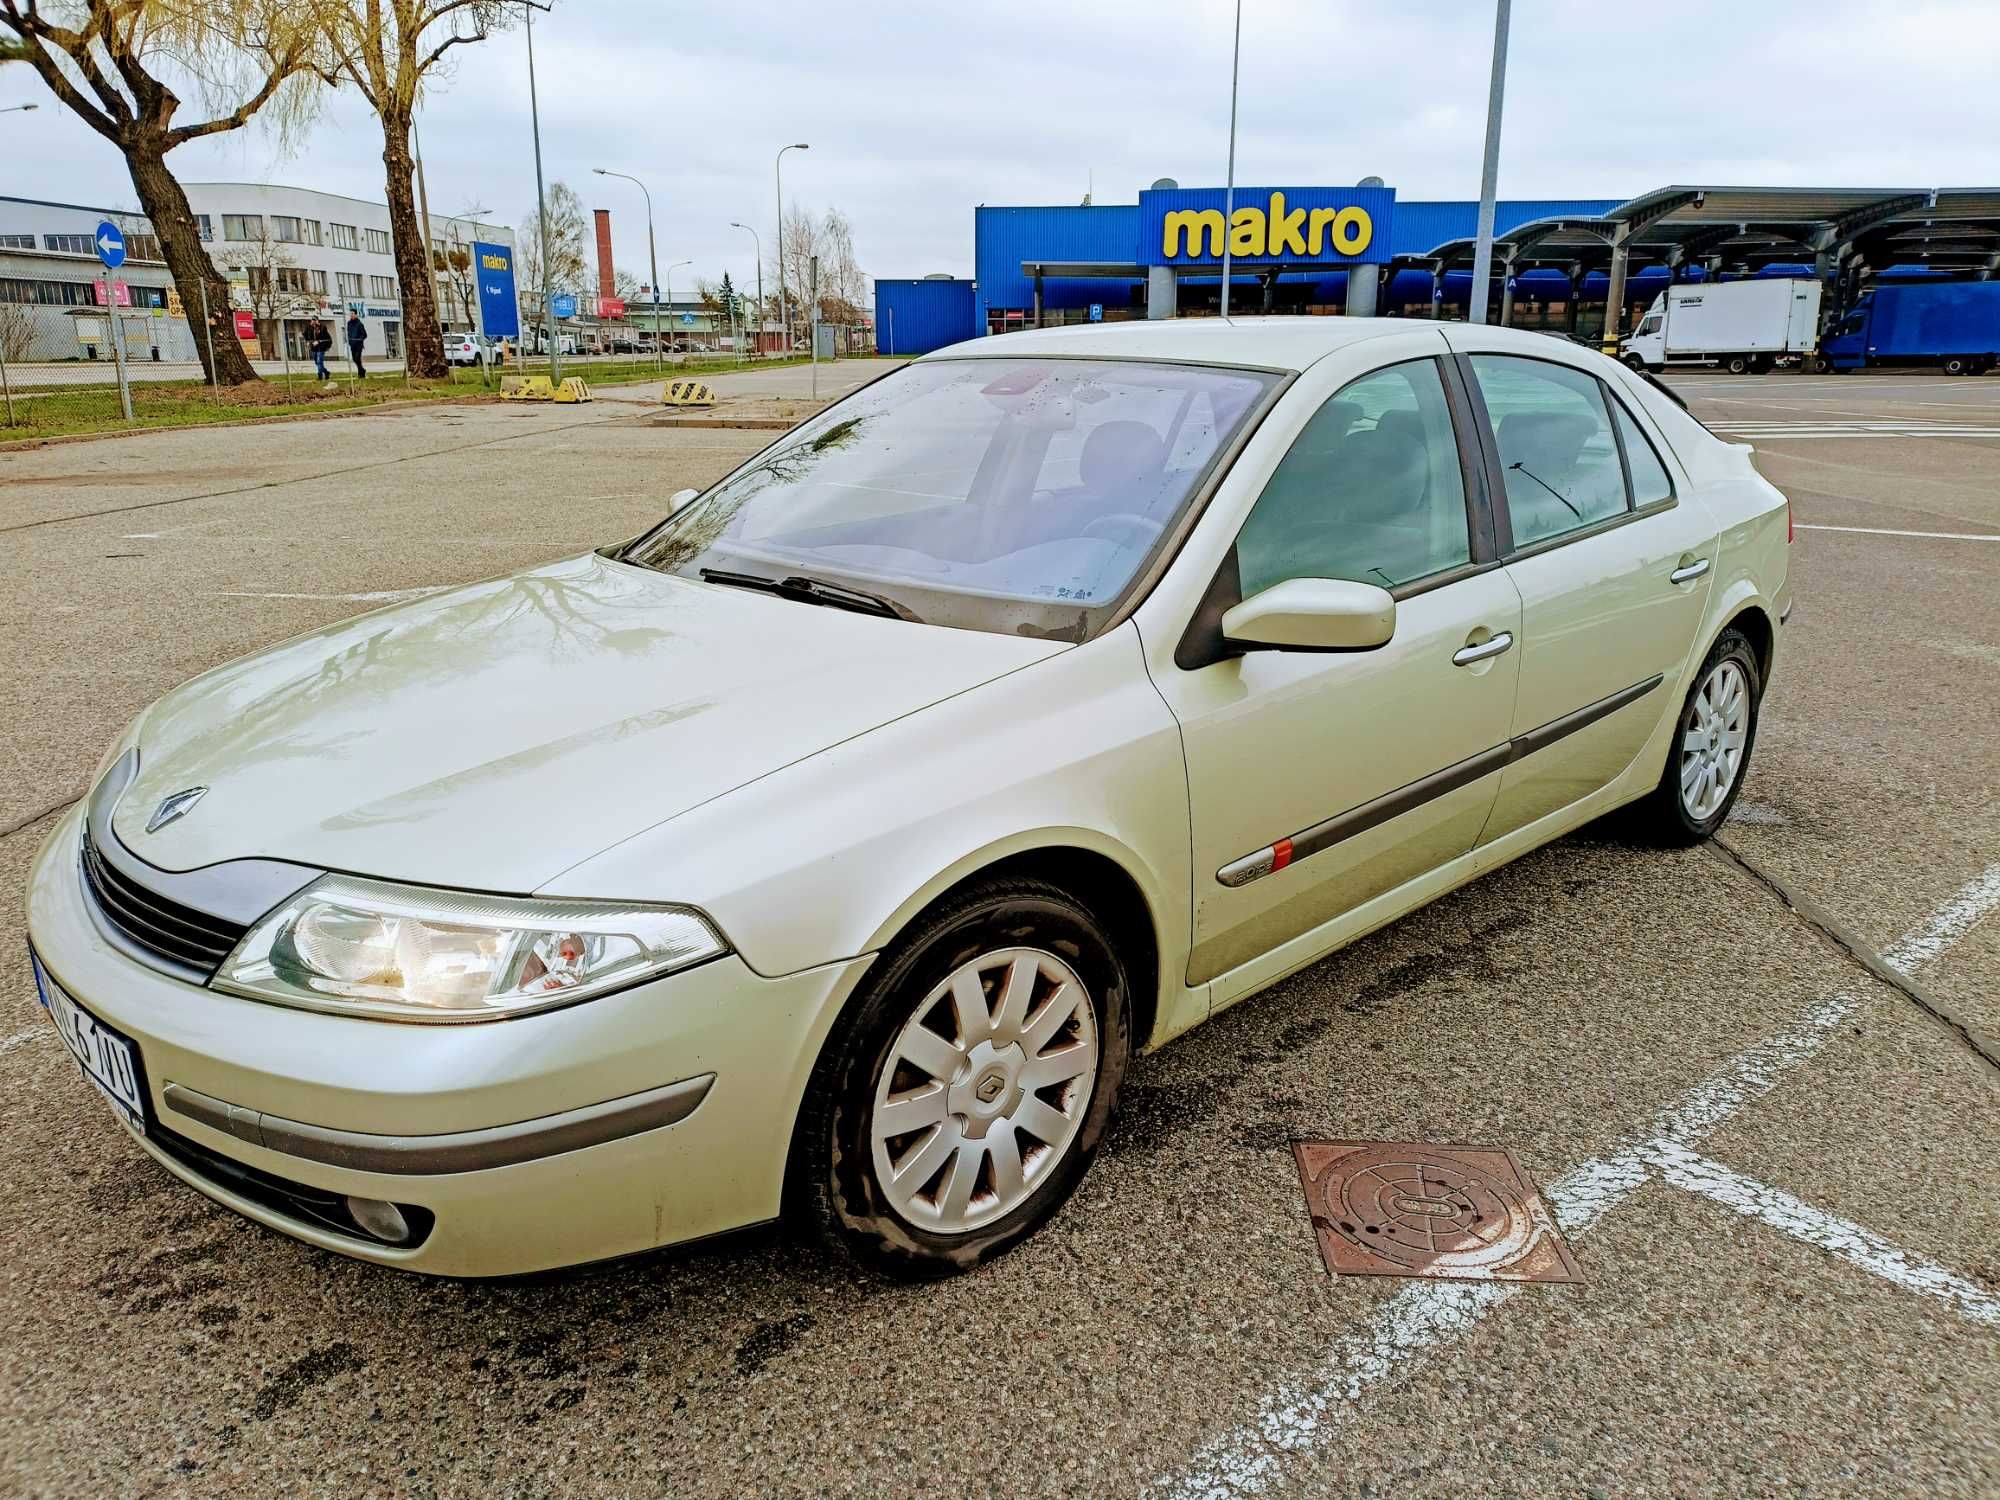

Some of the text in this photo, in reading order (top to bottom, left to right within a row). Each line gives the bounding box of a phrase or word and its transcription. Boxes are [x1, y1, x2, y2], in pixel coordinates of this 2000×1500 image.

[1163, 191, 1373, 258] makro
[482, 253, 507, 270] makro
[1508, 278, 1517, 288] A
[1435, 289, 1442, 297] A
[1092, 305, 1100, 318] P
